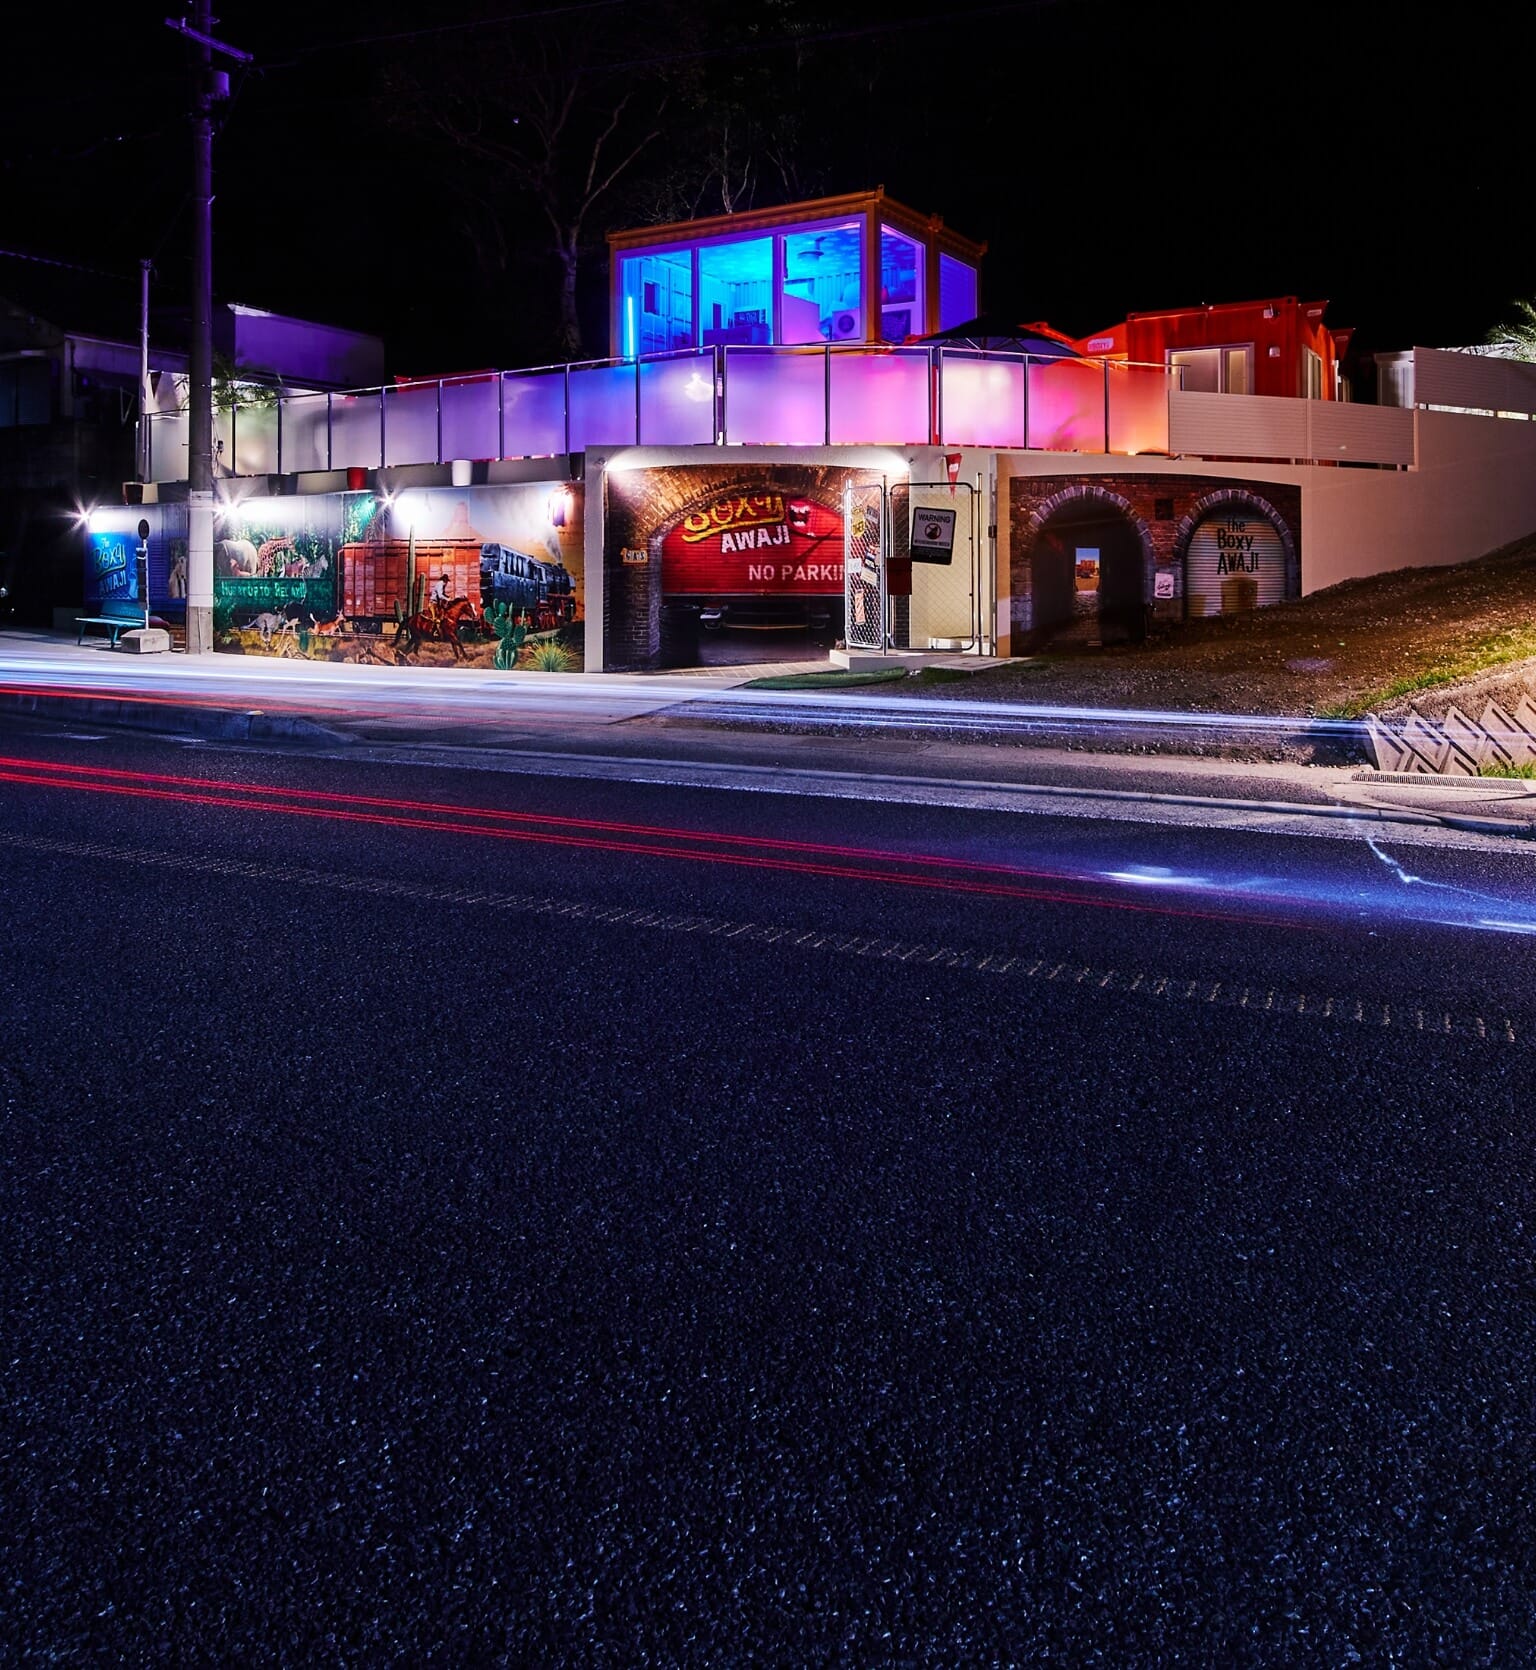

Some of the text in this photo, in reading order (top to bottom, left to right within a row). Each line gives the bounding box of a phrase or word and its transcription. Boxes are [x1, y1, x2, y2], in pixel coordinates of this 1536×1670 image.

[918, 513, 951, 524] WARNING
[720, 524, 791, 554] AWAJI
[748, 565, 775, 581] NO
[1217, 552, 1260, 575] AWAJI
